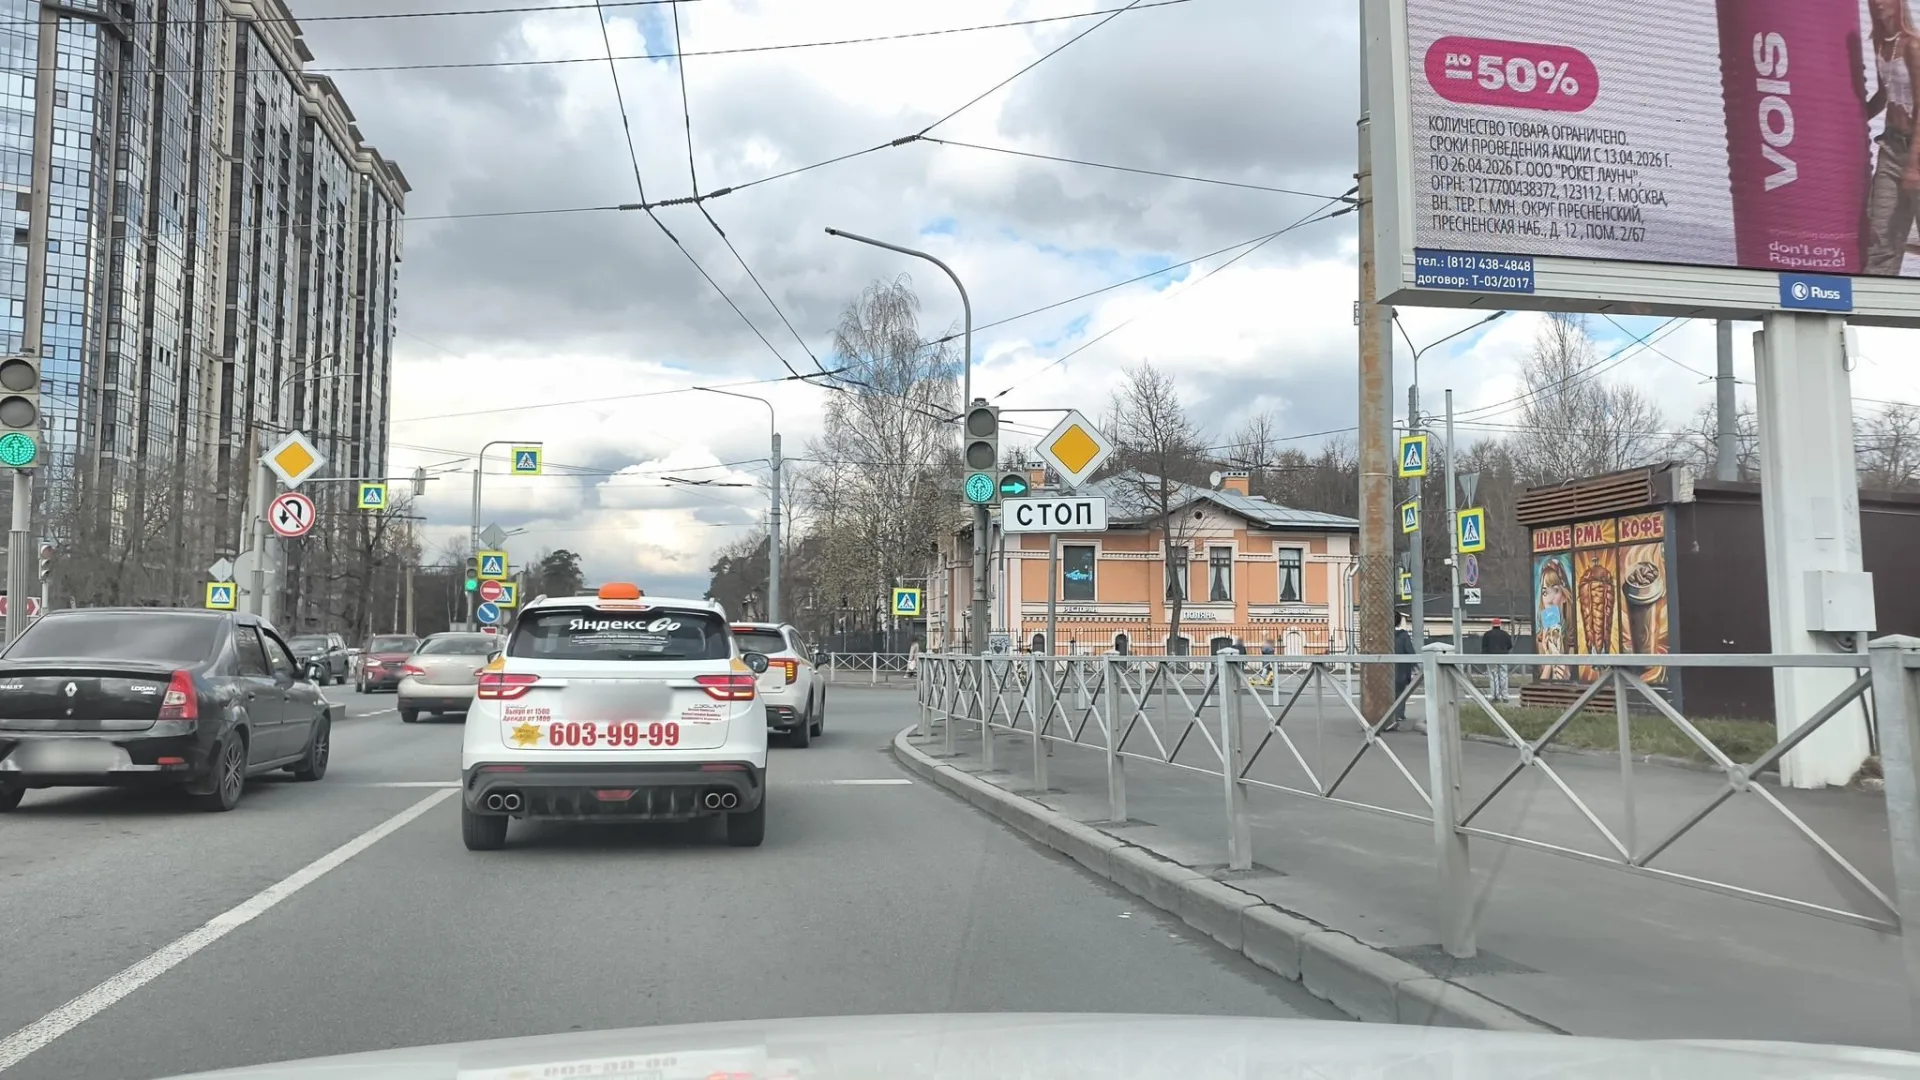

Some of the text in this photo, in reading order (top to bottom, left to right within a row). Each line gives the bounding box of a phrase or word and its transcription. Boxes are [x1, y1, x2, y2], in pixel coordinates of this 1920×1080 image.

[1444, 53, 1471, 67] до
[1753, 32, 1798, 192] VOIS
[1428, 116, 1629, 146] КОЛИЧЕСТВО ТОВАРА ОГРАНИЧЕНО.
[1430, 135, 1673, 168] СРОКИ ПРОВЕДЕНИЯ АКЦИИ С 13.04.2026 Г.
[1430, 155, 1448, 171] ПО
[1451, 156, 1512, 175] 26.04.2026
[1515, 161, 1523, 176] Г.
[1526, 162, 1552, 178] ООО
[1555, 163, 1595, 181] "РОКЕТ
[1431, 175, 1465, 192] ОГРН:
[1469, 177, 1560, 200] 1217700438372,
[1563, 183, 1605, 203] 123112,
[1607, 187, 1616, 202] Г.
[1431, 195, 1644, 224] ВН. ТЕР. Г. МУН. ОКРУГ ПРЕСНЕНСКИЙ,
[1432, 215, 1514, 234] ПРЕСНЕНСКАЯ
[1586, 224, 1618, 240] ПОМ.
[1620, 226, 1645, 242] 2/67
[1417, 255, 1531, 272] тел.: (812) 438-4848
[1417, 274, 1469, 287] договор:
[1016, 502, 1092, 526] СТОП
[1621, 515, 1662, 539] КОФЕ
[568, 617, 682, 632] Яндекс Go
[549, 721, 680, 747] 603-99-99
